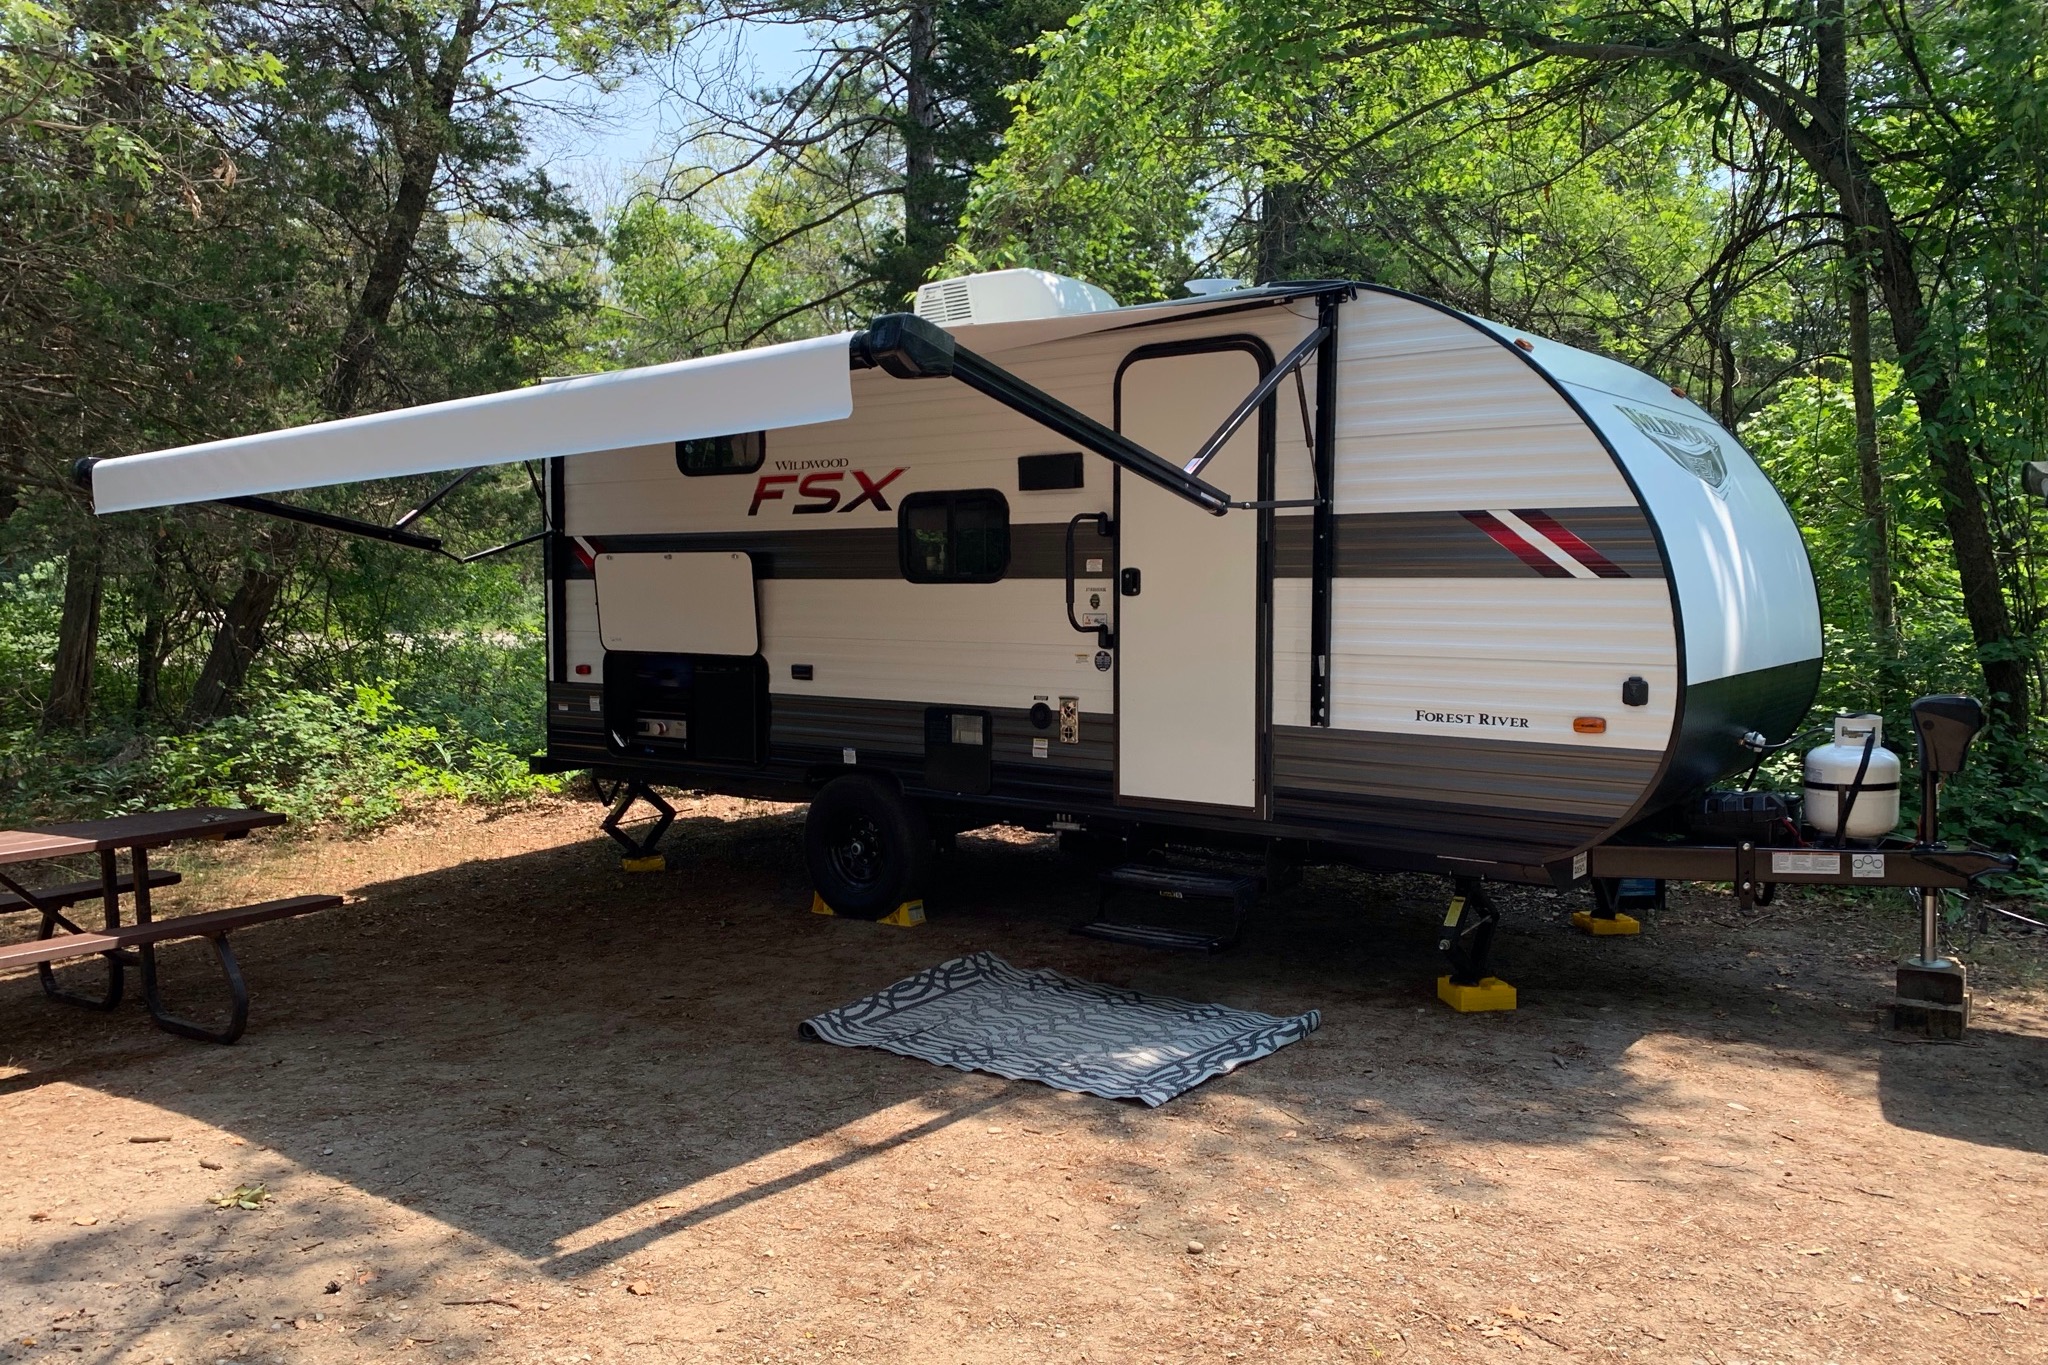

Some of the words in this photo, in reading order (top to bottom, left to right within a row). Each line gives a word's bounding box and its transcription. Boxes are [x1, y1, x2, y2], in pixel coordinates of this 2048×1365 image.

[775, 458, 848, 471] WILDWOOD
[747, 466, 911, 516] FSX
[1415, 709, 1474, 724] FOREST
[1478, 712, 1529, 728] RIVER
